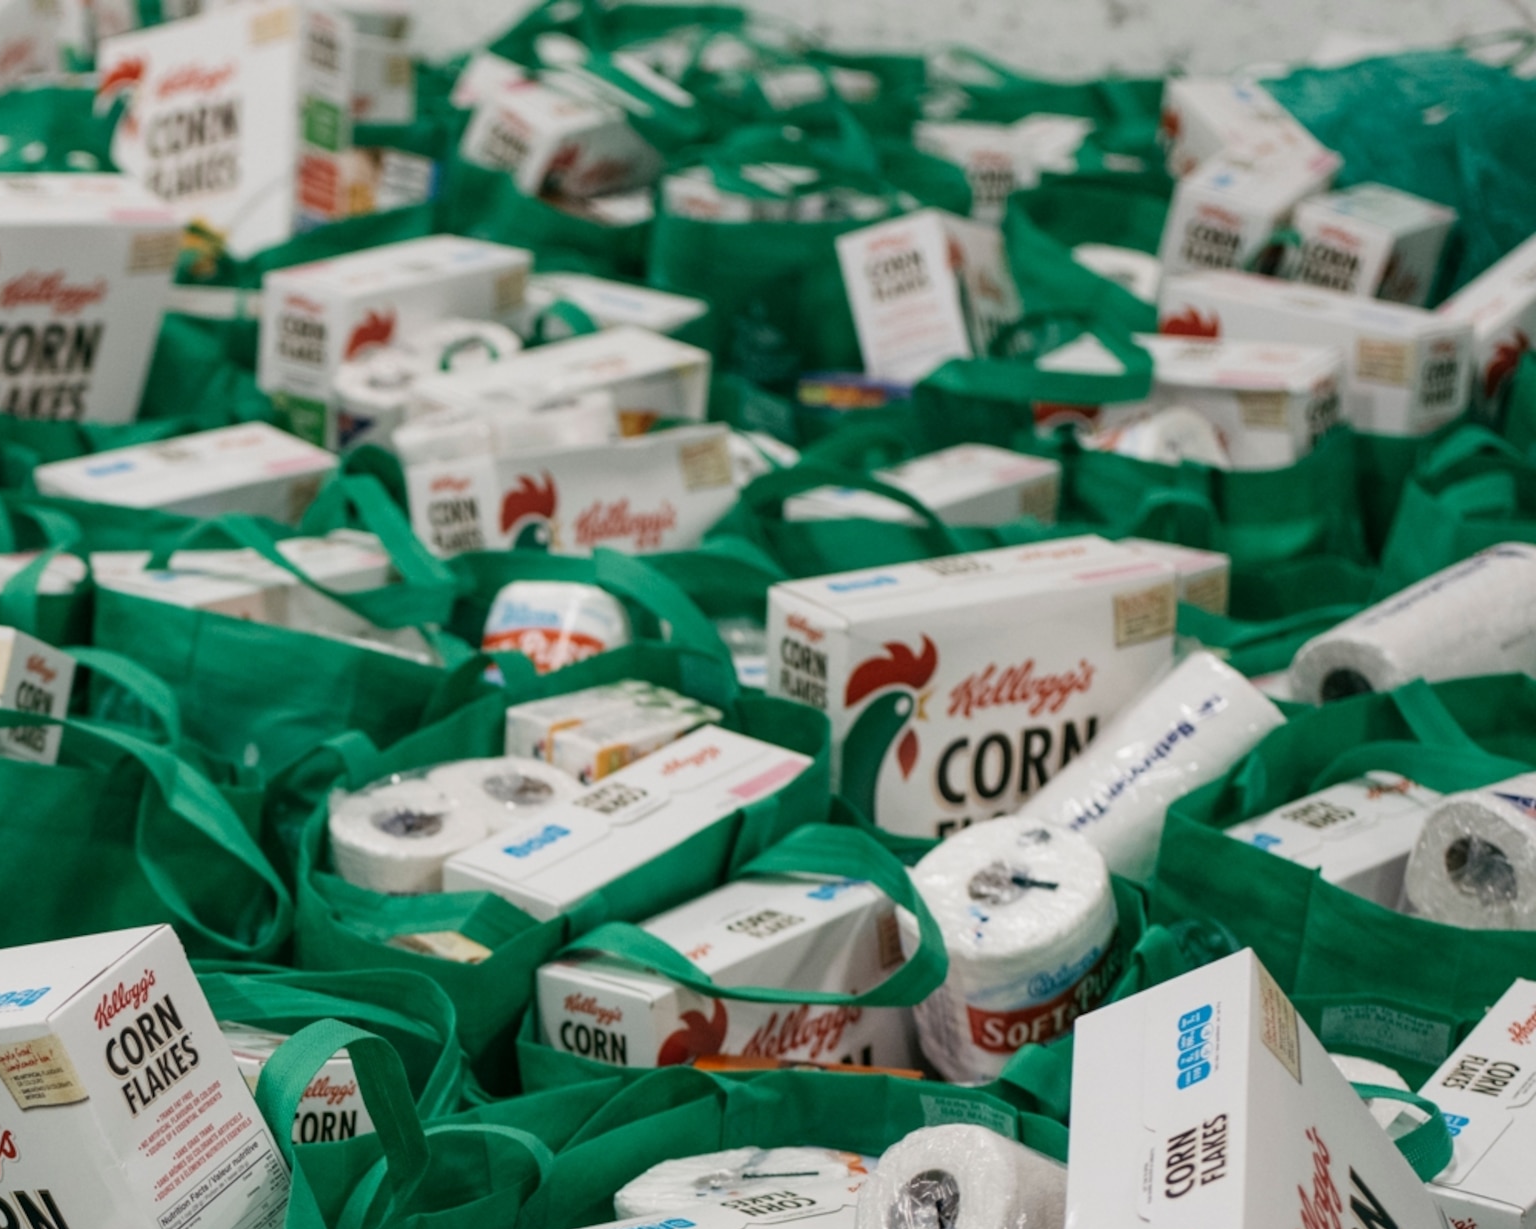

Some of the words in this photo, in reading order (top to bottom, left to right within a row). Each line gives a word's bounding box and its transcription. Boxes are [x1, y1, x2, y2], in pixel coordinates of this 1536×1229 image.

[0, 272, 108, 313] Kellogg's
[573, 498, 677, 548] Kellogg's
[780, 637, 827, 680] CORN
[15, 682, 53, 717] CORN
[948, 659, 1095, 718] Kellogg's
[935, 717, 1099, 804] CORN
[94, 967, 156, 1030] Kellogg's
[563, 994, 622, 1022] Kellogg's
[105, 994, 185, 1076] CORN
[560, 1019, 628, 1066] CORN
[983, 1008, 1068, 1050] SOFT
[121, 1035, 202, 1117] FLAKES
[299, 1075, 355, 1101] ellogg's
[1441, 1054, 1490, 1091] FLAKES
[1469, 1060, 1521, 1098] CORN
[292, 1110, 357, 1145] CORN
[1164, 1127, 1198, 1199] CORN
[1200, 1112, 1228, 1188] FLAKES
[160, 1196, 192, 1227] Nutrition
[189, 1183, 210, 1202] Facts
[231, 1140, 260, 1169] nutritive
[720, 1189, 800, 1214] FLAKES
[740, 1194, 818, 1217] CORN
